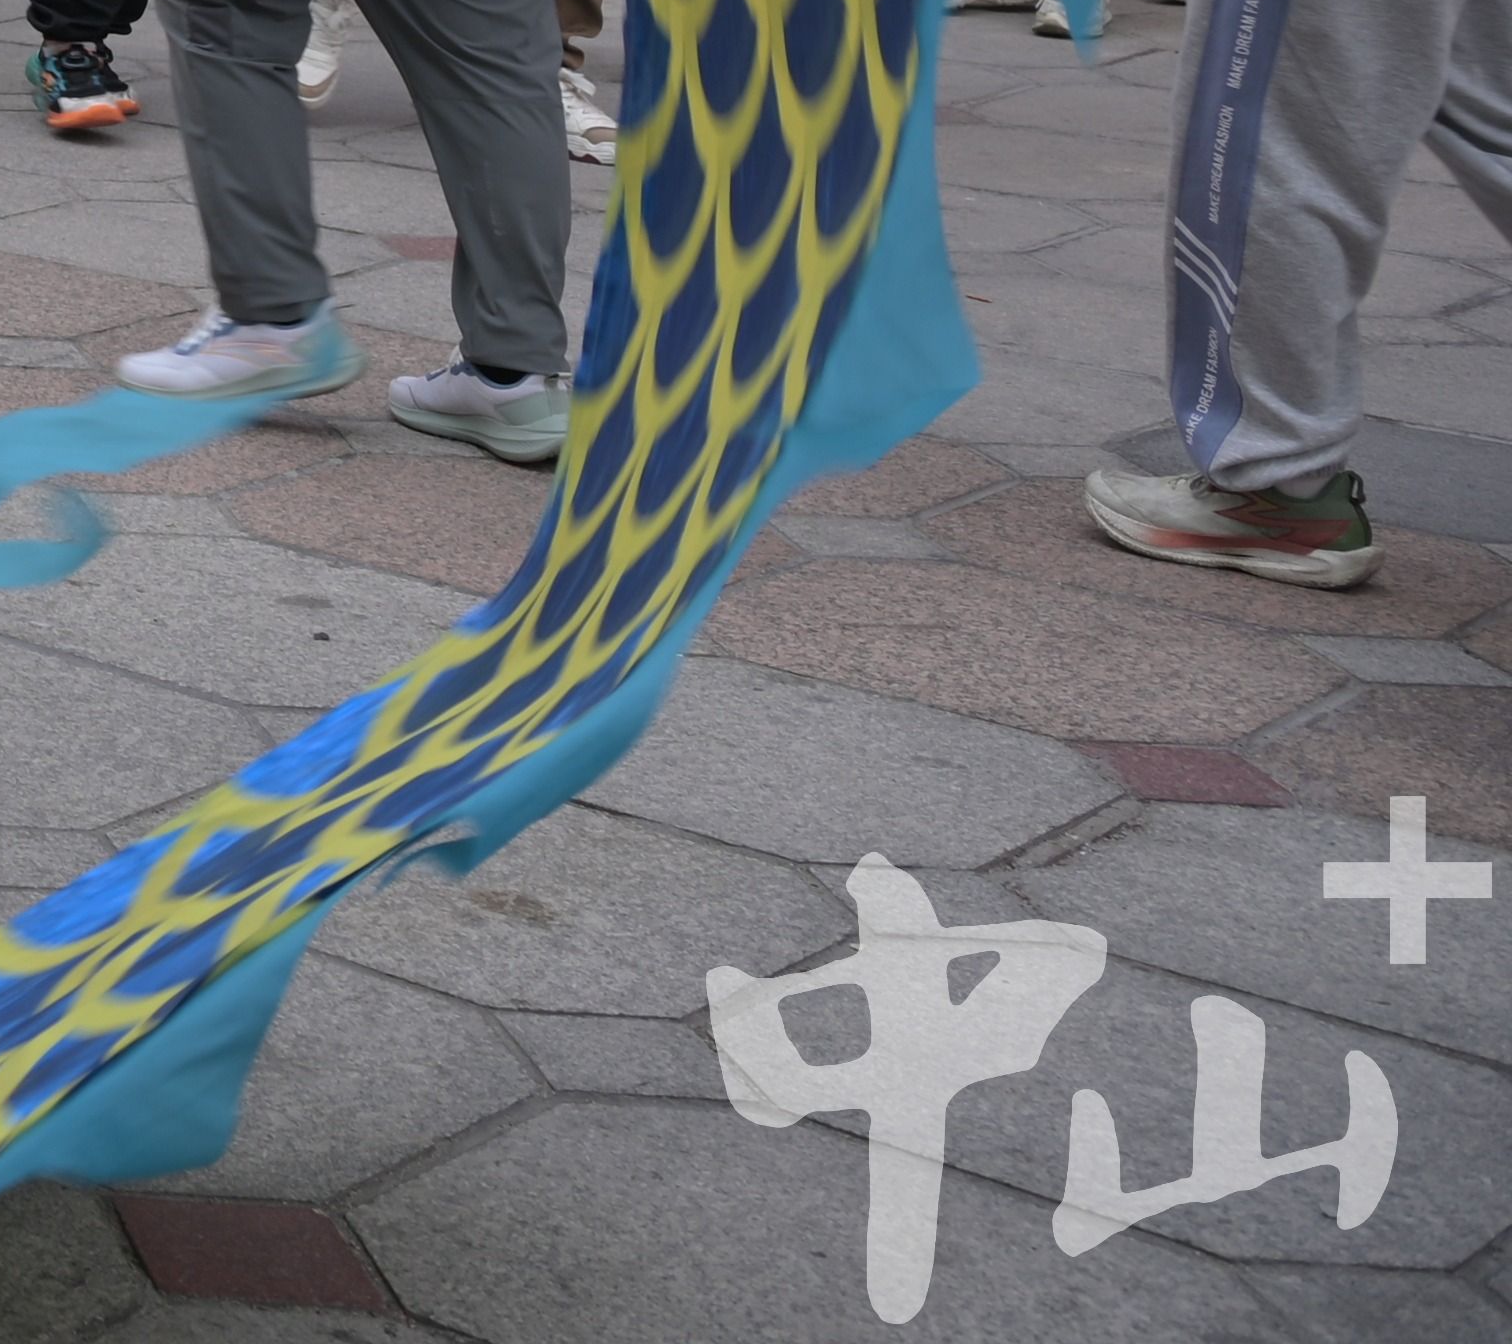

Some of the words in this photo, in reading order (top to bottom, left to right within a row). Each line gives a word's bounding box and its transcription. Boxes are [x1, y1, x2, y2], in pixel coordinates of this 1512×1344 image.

[1235, 14, 1256, 56] DREAM
[1226, 55, 1248, 89] MAKE
[1214, 104, 1235, 153] FASHION
[1196, 373, 1217, 414] DREAM
